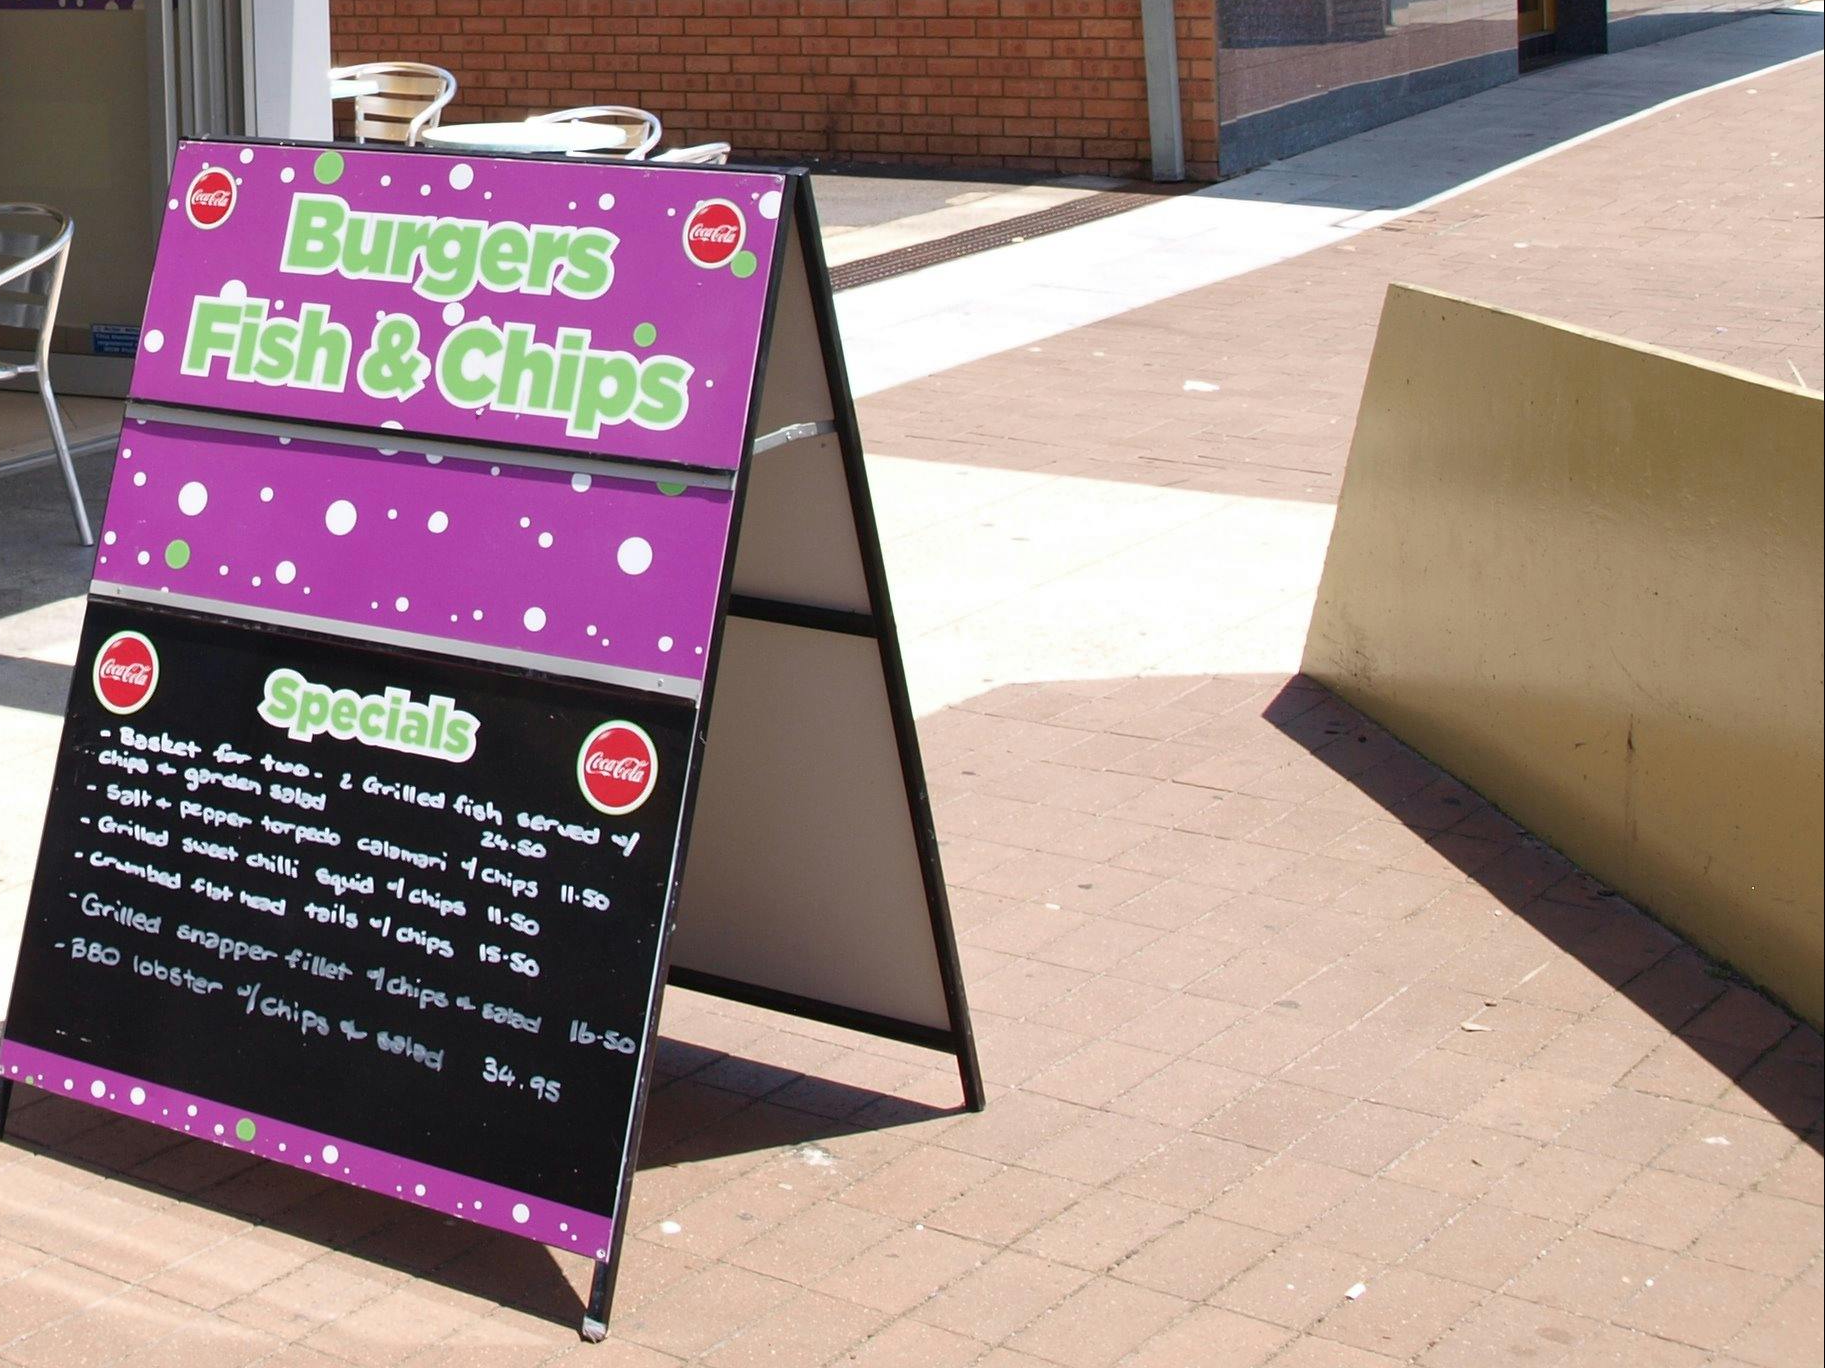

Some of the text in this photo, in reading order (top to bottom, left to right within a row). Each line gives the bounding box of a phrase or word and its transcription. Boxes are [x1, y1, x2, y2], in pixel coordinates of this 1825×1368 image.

[191, 188, 231, 207] Coca-Cola
[689, 222, 739, 243] Coca-Cola
[282, 194, 617, 301] Burgers
[183, 296, 692, 438] Fish & Chips
[100, 658, 152, 687] Coca-Cola
[261, 672, 478, 760] Specials
[98, 749, 149, 774] chips
[184, 767, 262, 796] garden
[269, 784, 327, 812] salad
[120, 726, 202, 759] Basket
[213, 743, 252, 765] for
[362, 775, 446, 810] Grilled
[453, 794, 504, 826] fish
[517, 812, 601, 845] served
[586, 751, 650, 784] Coca-Cola
[97, 815, 169, 848] Grilled
[181, 837, 240, 863] sweet
[245, 852, 300, 879] chilli
[314, 867, 375, 897] squid
[408, 888, 467, 918] chips
[106, 784, 152, 808] Salt
[180, 800, 253, 829] pepper
[261, 815, 342, 846] torpedo
[357, 836, 448, 872] calamari
[190, 877, 234, 903] flat
[239, 889, 287, 917] head
[304, 903, 359, 930] tails
[395, 925, 455, 959] chips
[81, 892, 161, 935] Grilled
[176, 924, 279, 962] snapper
[284, 947, 353, 982] fillet
[386, 975, 450, 1010] chips
[481, 1002, 543, 1034] salad
[132, 954, 224, 996] lobster
[260, 1000, 331, 1037] chips
[376, 1031, 446, 1073] salad
[482, 1055, 562, 1104] 34.95
